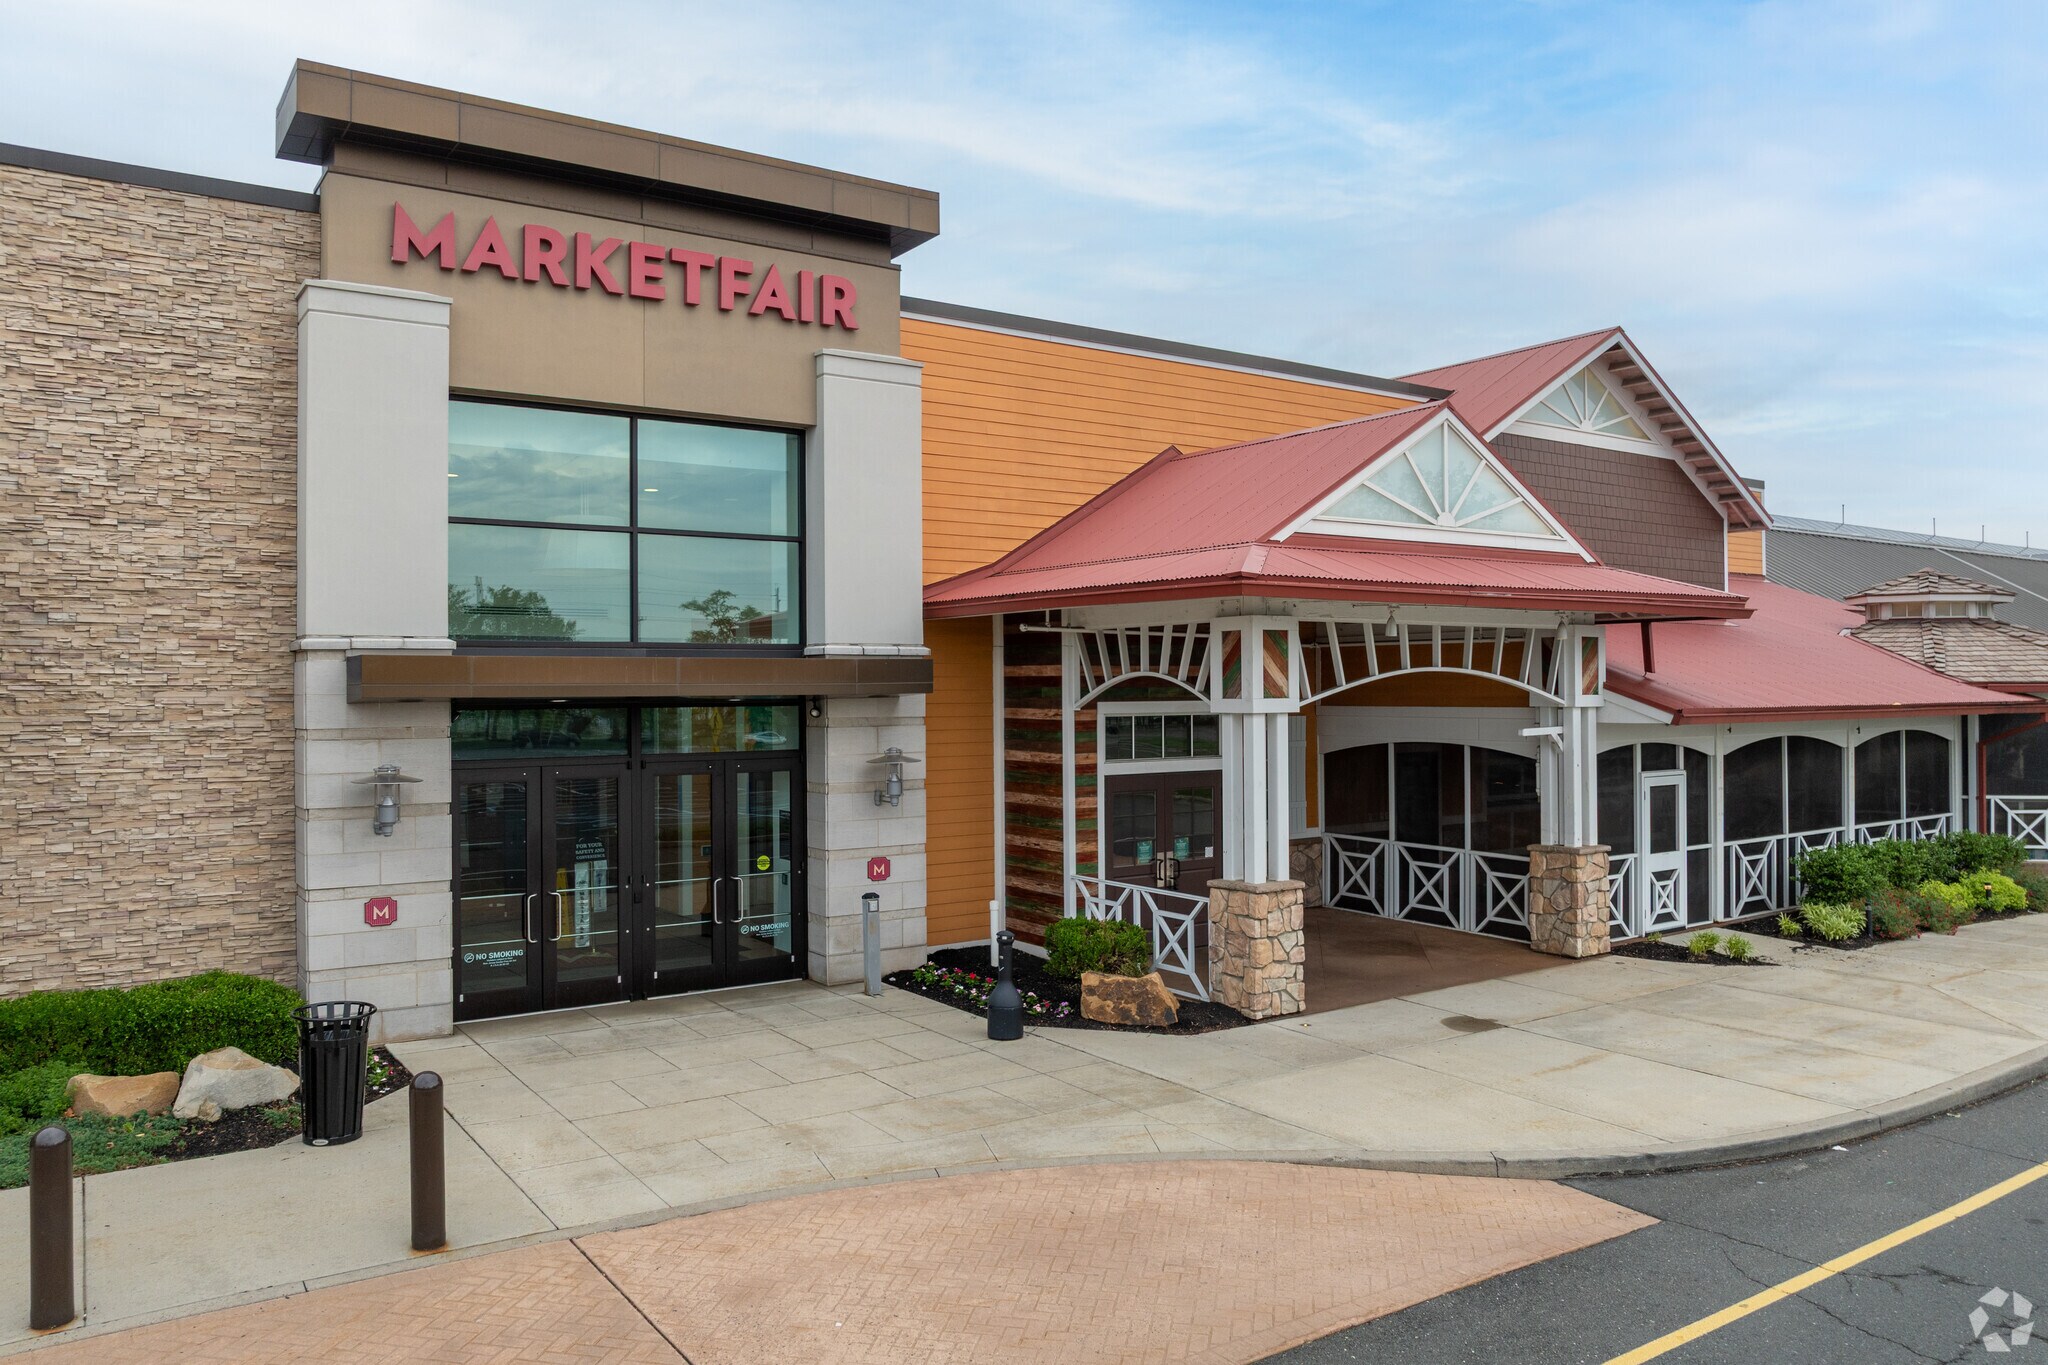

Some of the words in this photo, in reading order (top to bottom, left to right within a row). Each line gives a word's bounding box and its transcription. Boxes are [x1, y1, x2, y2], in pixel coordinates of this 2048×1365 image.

[391, 201, 859, 331] MARKETFAIR
[873, 863, 885, 876] M
[373, 904, 390, 920] M
[760, 922, 790, 931] SMOKING
[488, 949, 524, 959] SMOKING
